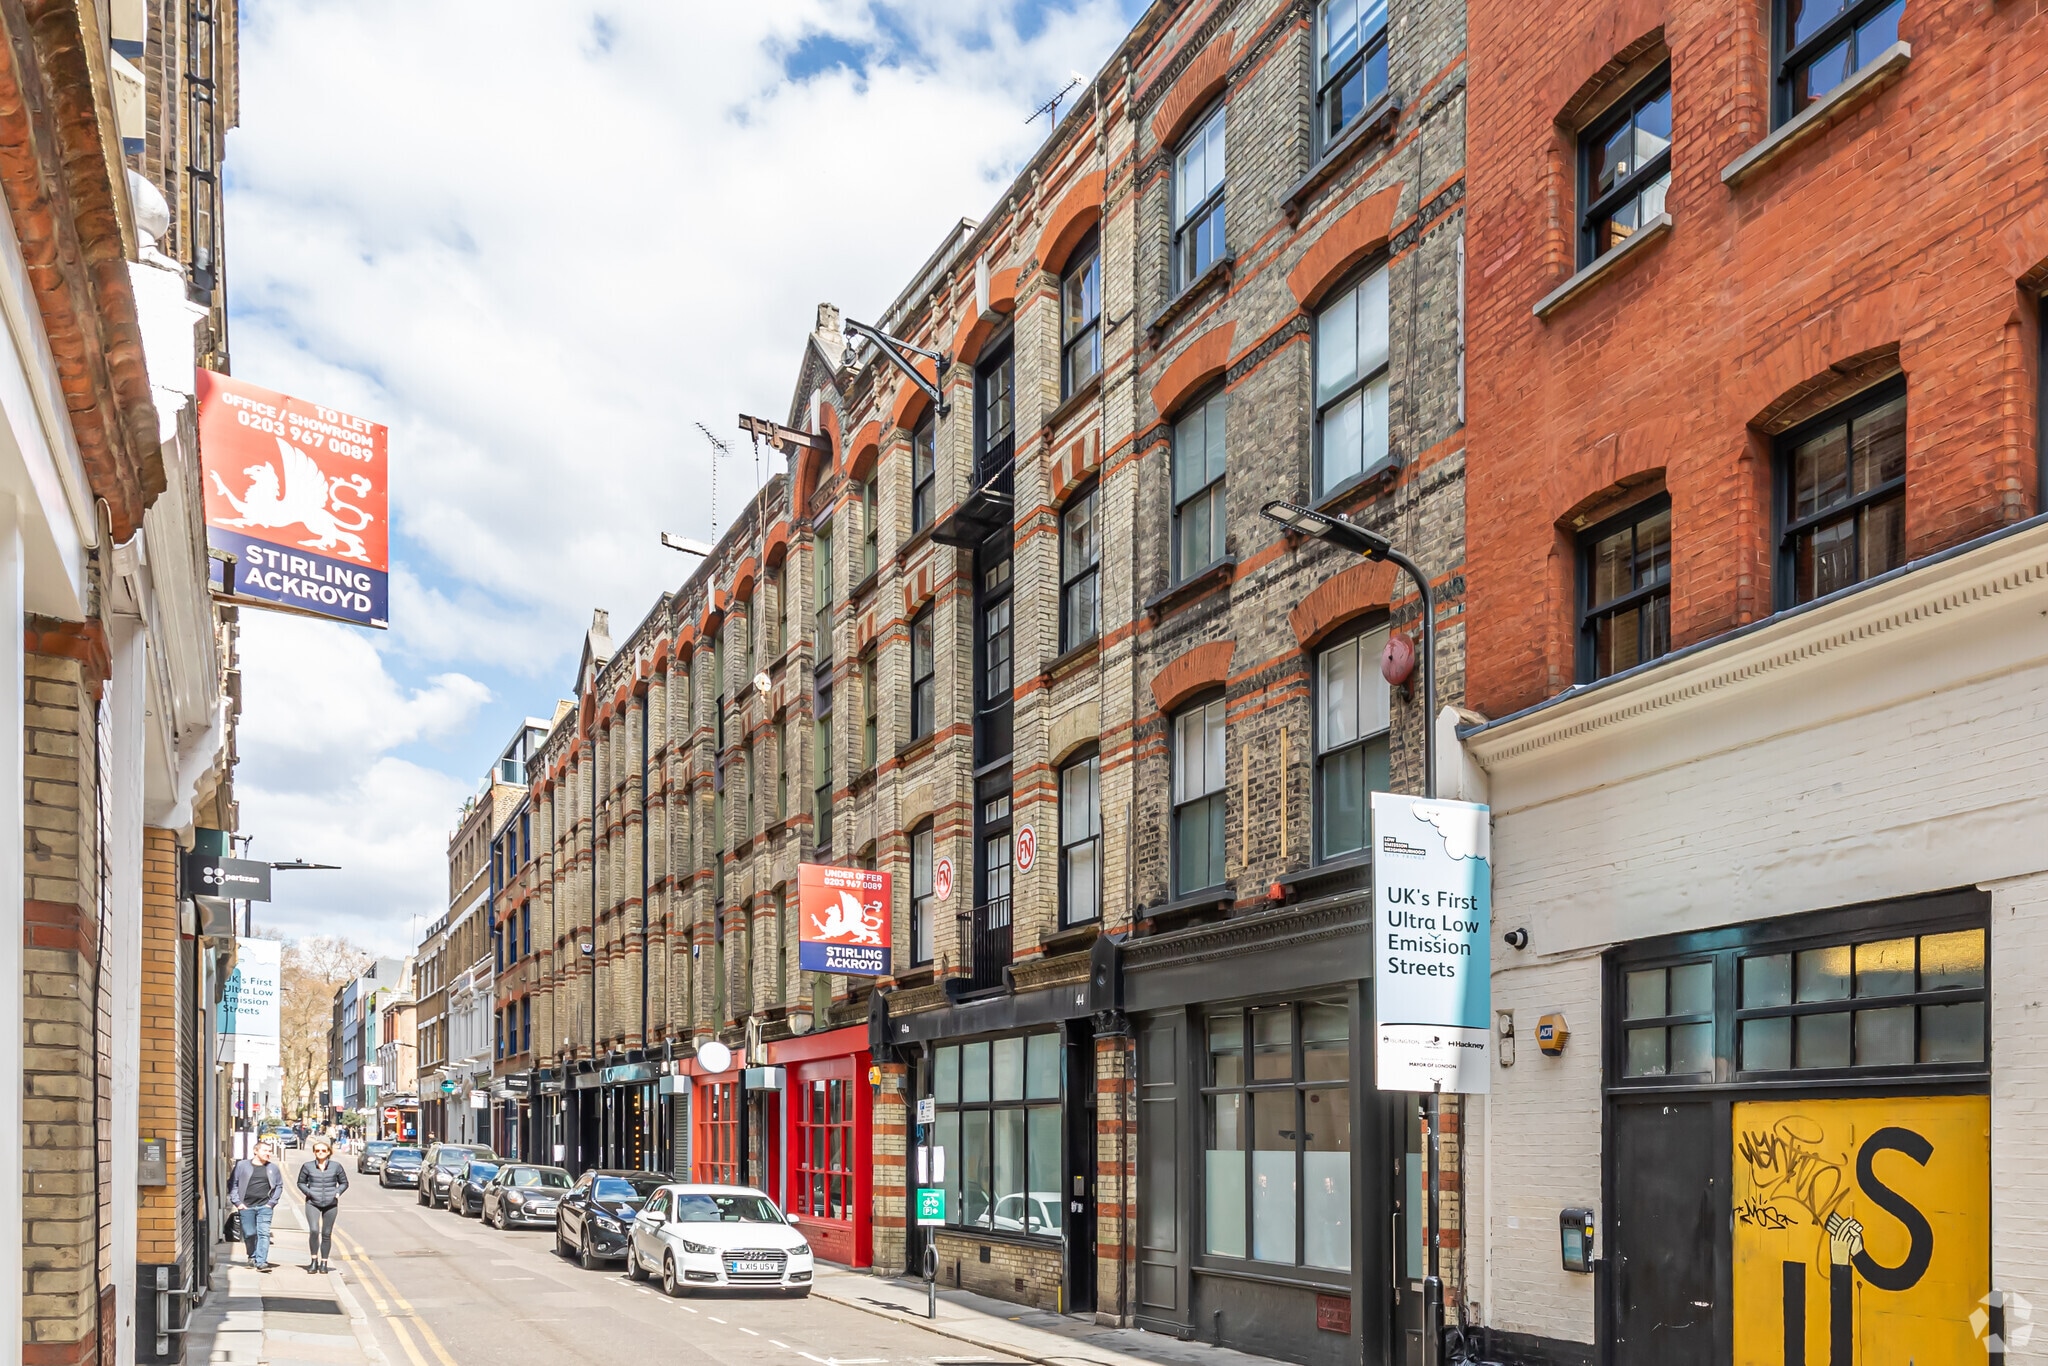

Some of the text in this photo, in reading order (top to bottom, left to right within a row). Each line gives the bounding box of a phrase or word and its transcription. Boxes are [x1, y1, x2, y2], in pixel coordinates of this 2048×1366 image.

[222, 392, 277, 418] OFFICE
[288, 412, 373, 449] SHOWROOM
[315, 405, 373, 435] TO LET
[237, 410, 373, 463] 0203 967 0089
[245, 544, 372, 592] STIRLING
[244, 566, 372, 613] ACKROYD
[824, 869, 882, 883] UNDER OFFER
[824, 877, 882, 890] 0203 967 0089
[1388, 886, 1478, 911] UK's First
[1388, 910, 1479, 934] Ultra Low
[1388, 934, 1471, 956] Emission
[826, 946, 883, 960] STIRLING
[826, 957, 883, 971] ACKROYD
[1388, 957, 1455, 978] Streets
[250, 977, 272, 987] First
[224, 985, 273, 996] Ultra Low
[223, 995, 269, 1006] Emission
[222, 1004, 260, 1015] Streets
[1540, 1028, 1553, 1037] ADT
[1455, 1041, 1485, 1050] Hackney
[760, 1263, 774, 1271] USV
